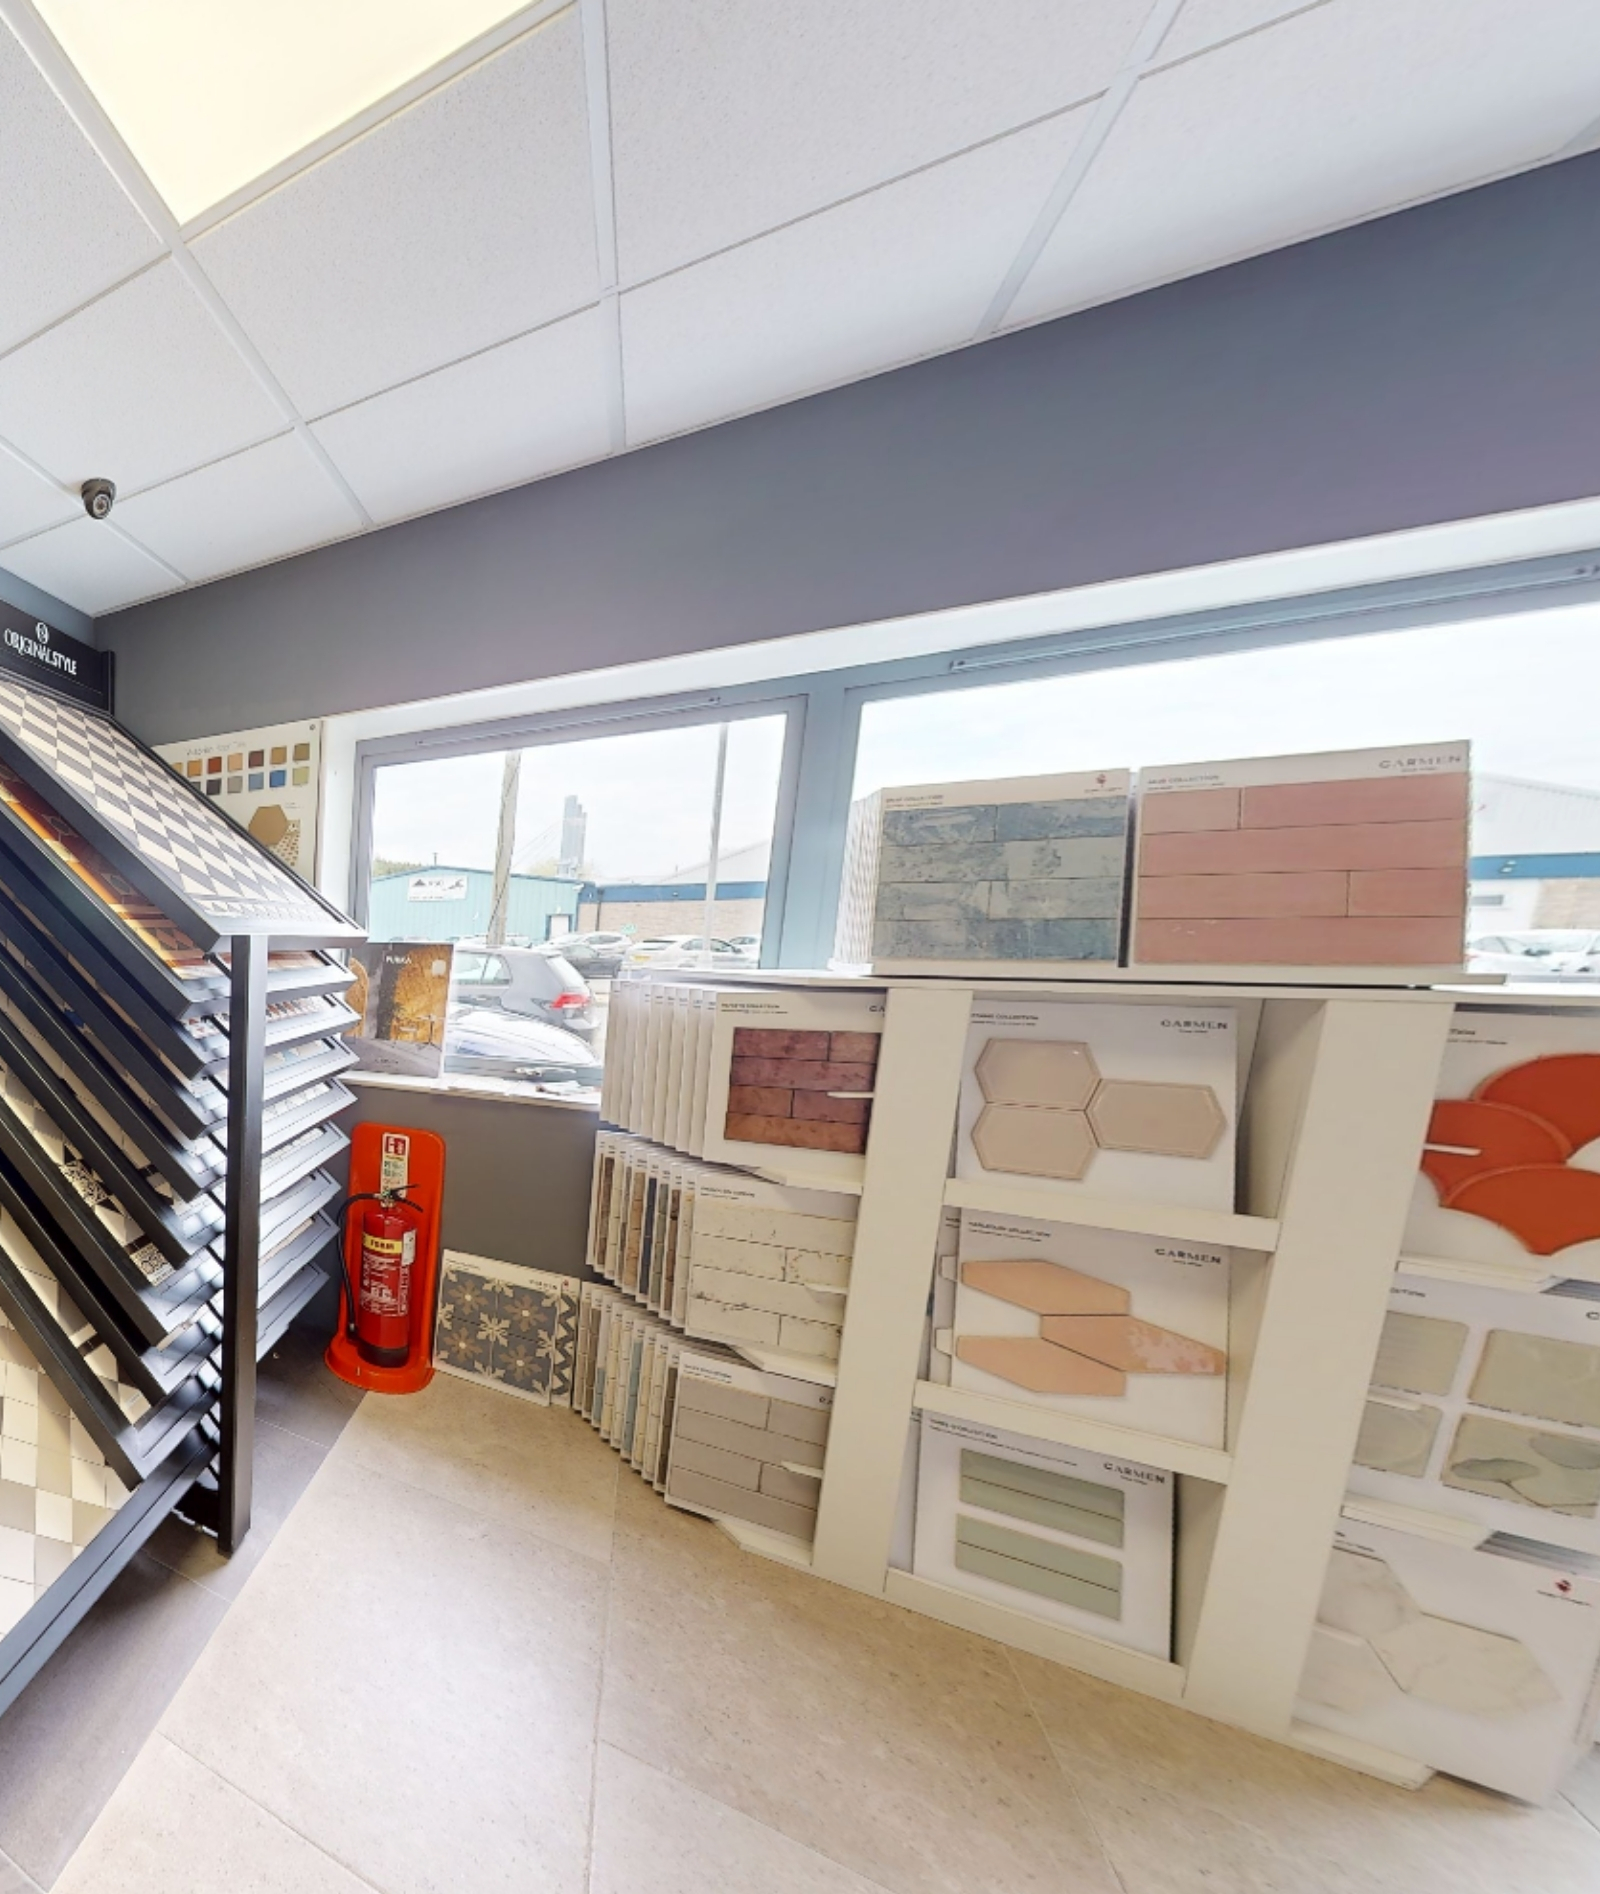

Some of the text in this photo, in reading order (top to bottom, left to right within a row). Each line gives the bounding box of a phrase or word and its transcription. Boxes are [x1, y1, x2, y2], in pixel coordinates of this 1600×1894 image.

[1378, 755, 1462, 770] CARMEN
[1160, 1018, 1228, 1030] CARMEN
[1154, 1248, 1221, 1265] CARMEN
[1103, 1462, 1166, 1484] CARMEN
